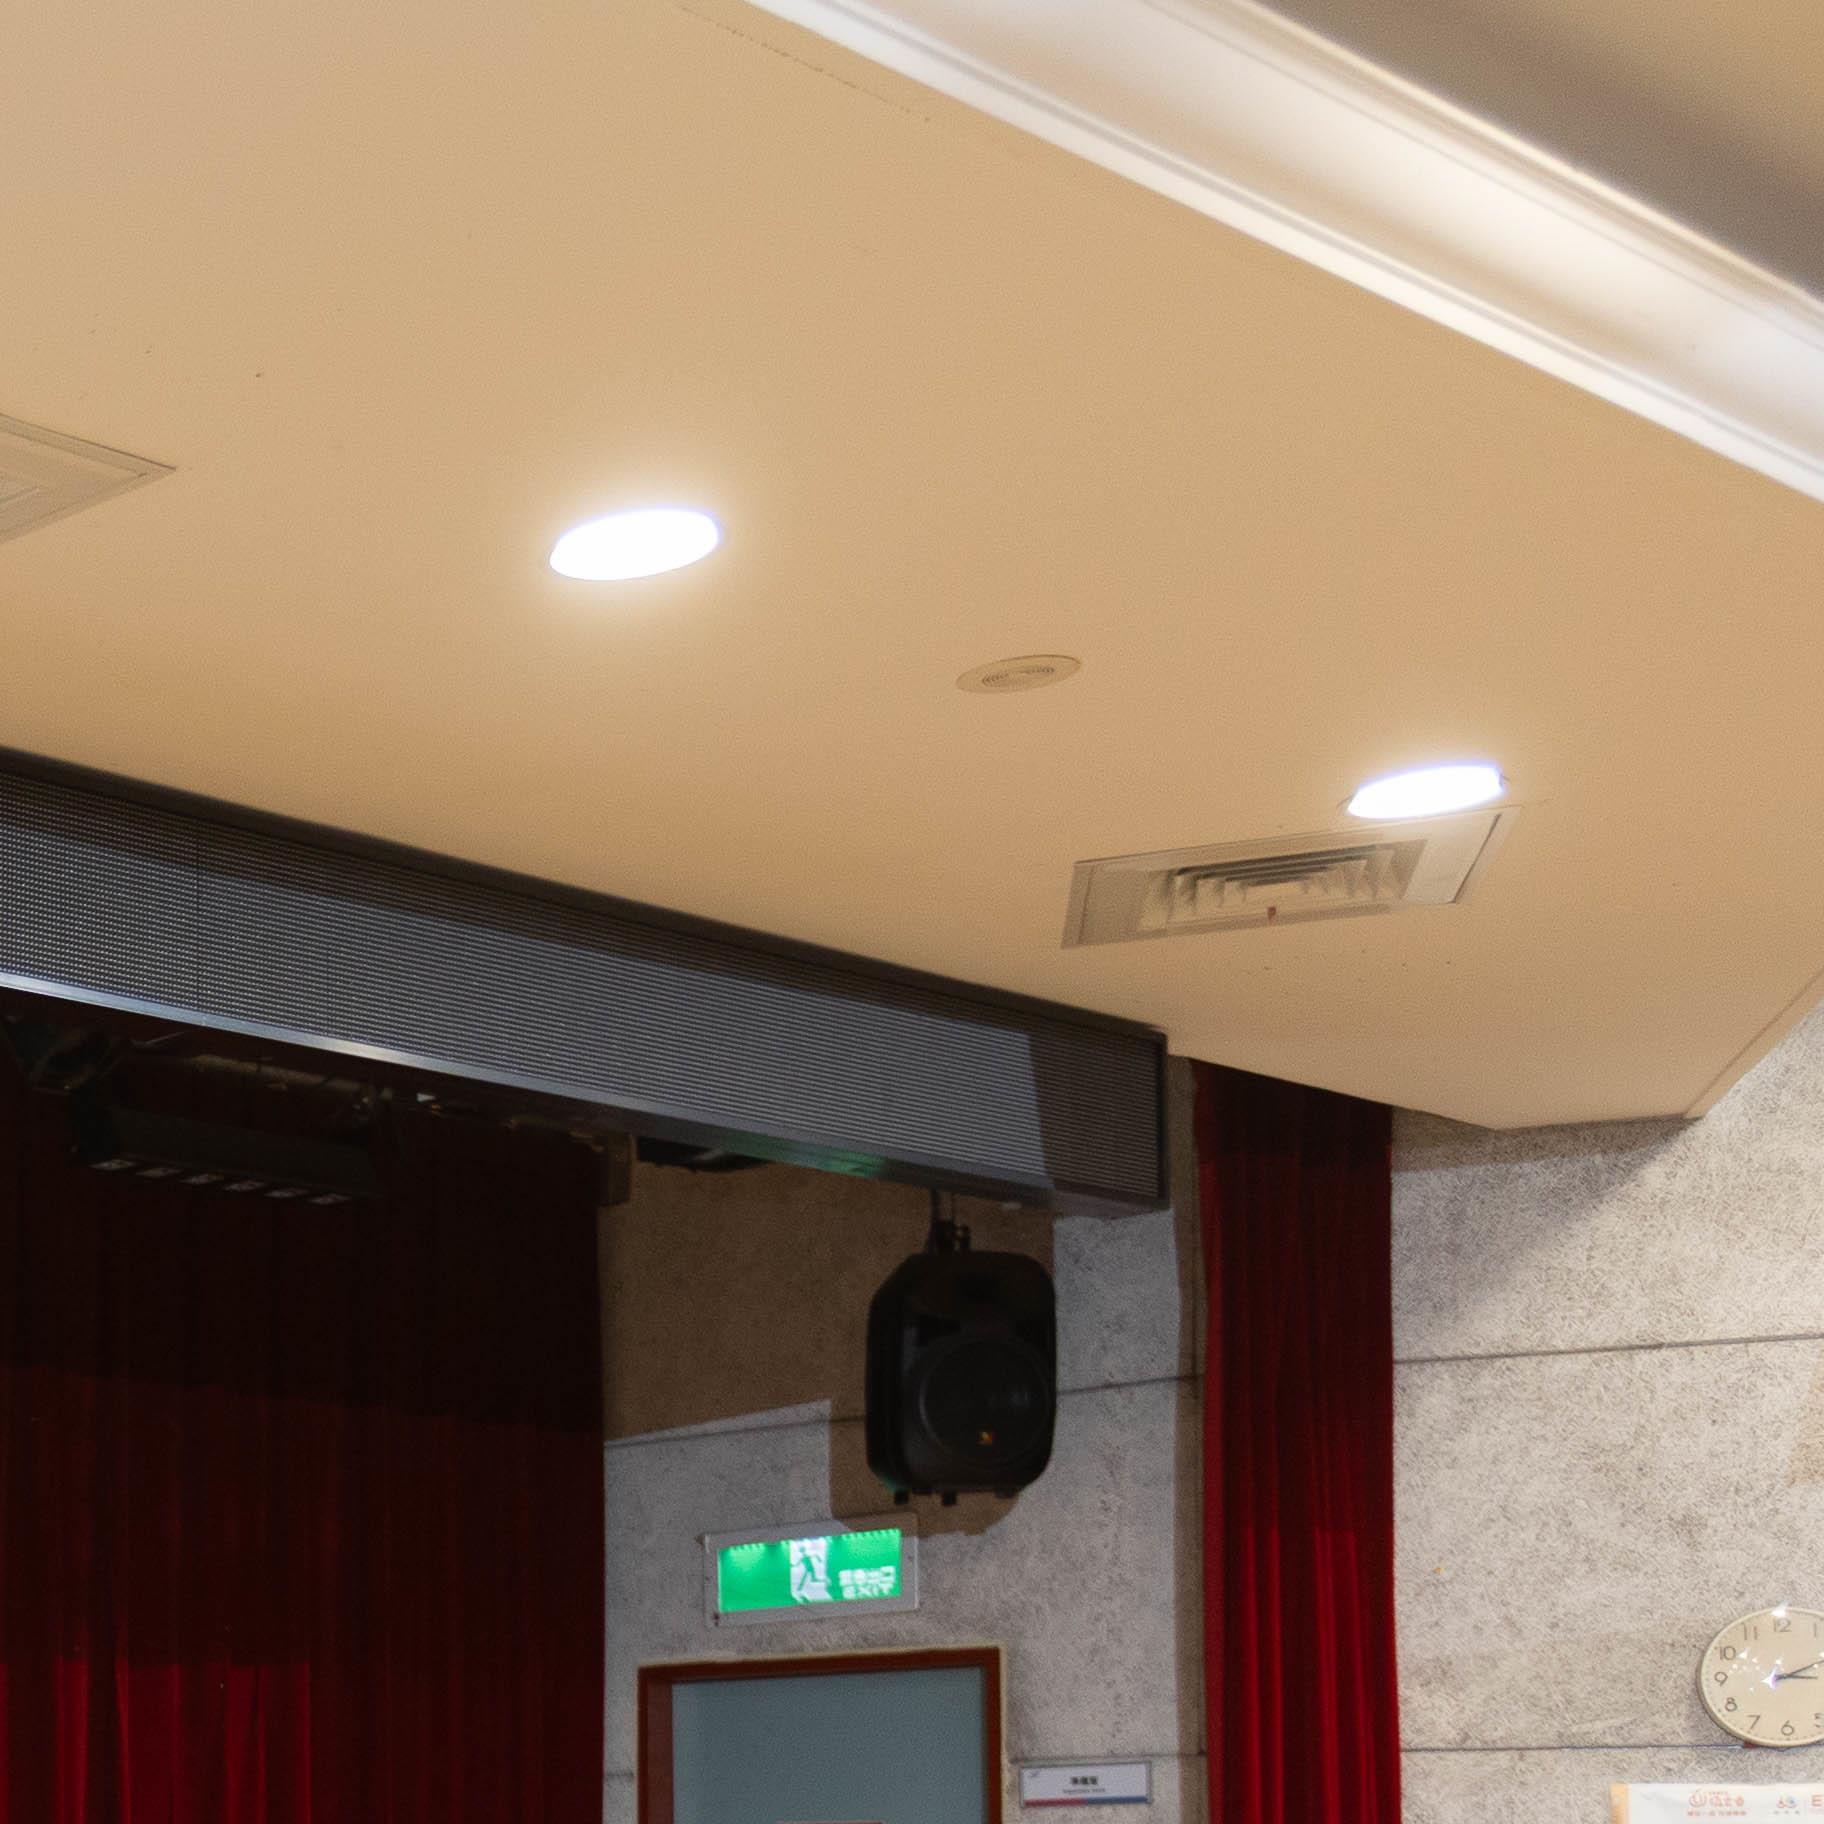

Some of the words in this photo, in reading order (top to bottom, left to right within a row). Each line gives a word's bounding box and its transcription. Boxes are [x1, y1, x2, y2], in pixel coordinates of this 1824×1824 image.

[1773, 1618, 1791, 1632] 12
[1719, 1646, 1736, 1660] 10
[1714, 1671, 1728, 1687] 9
[1725, 1697, 1737, 1712] 8
[1747, 1714, 1760, 1730] 7
[1781, 1719, 1794, 1736] 6
